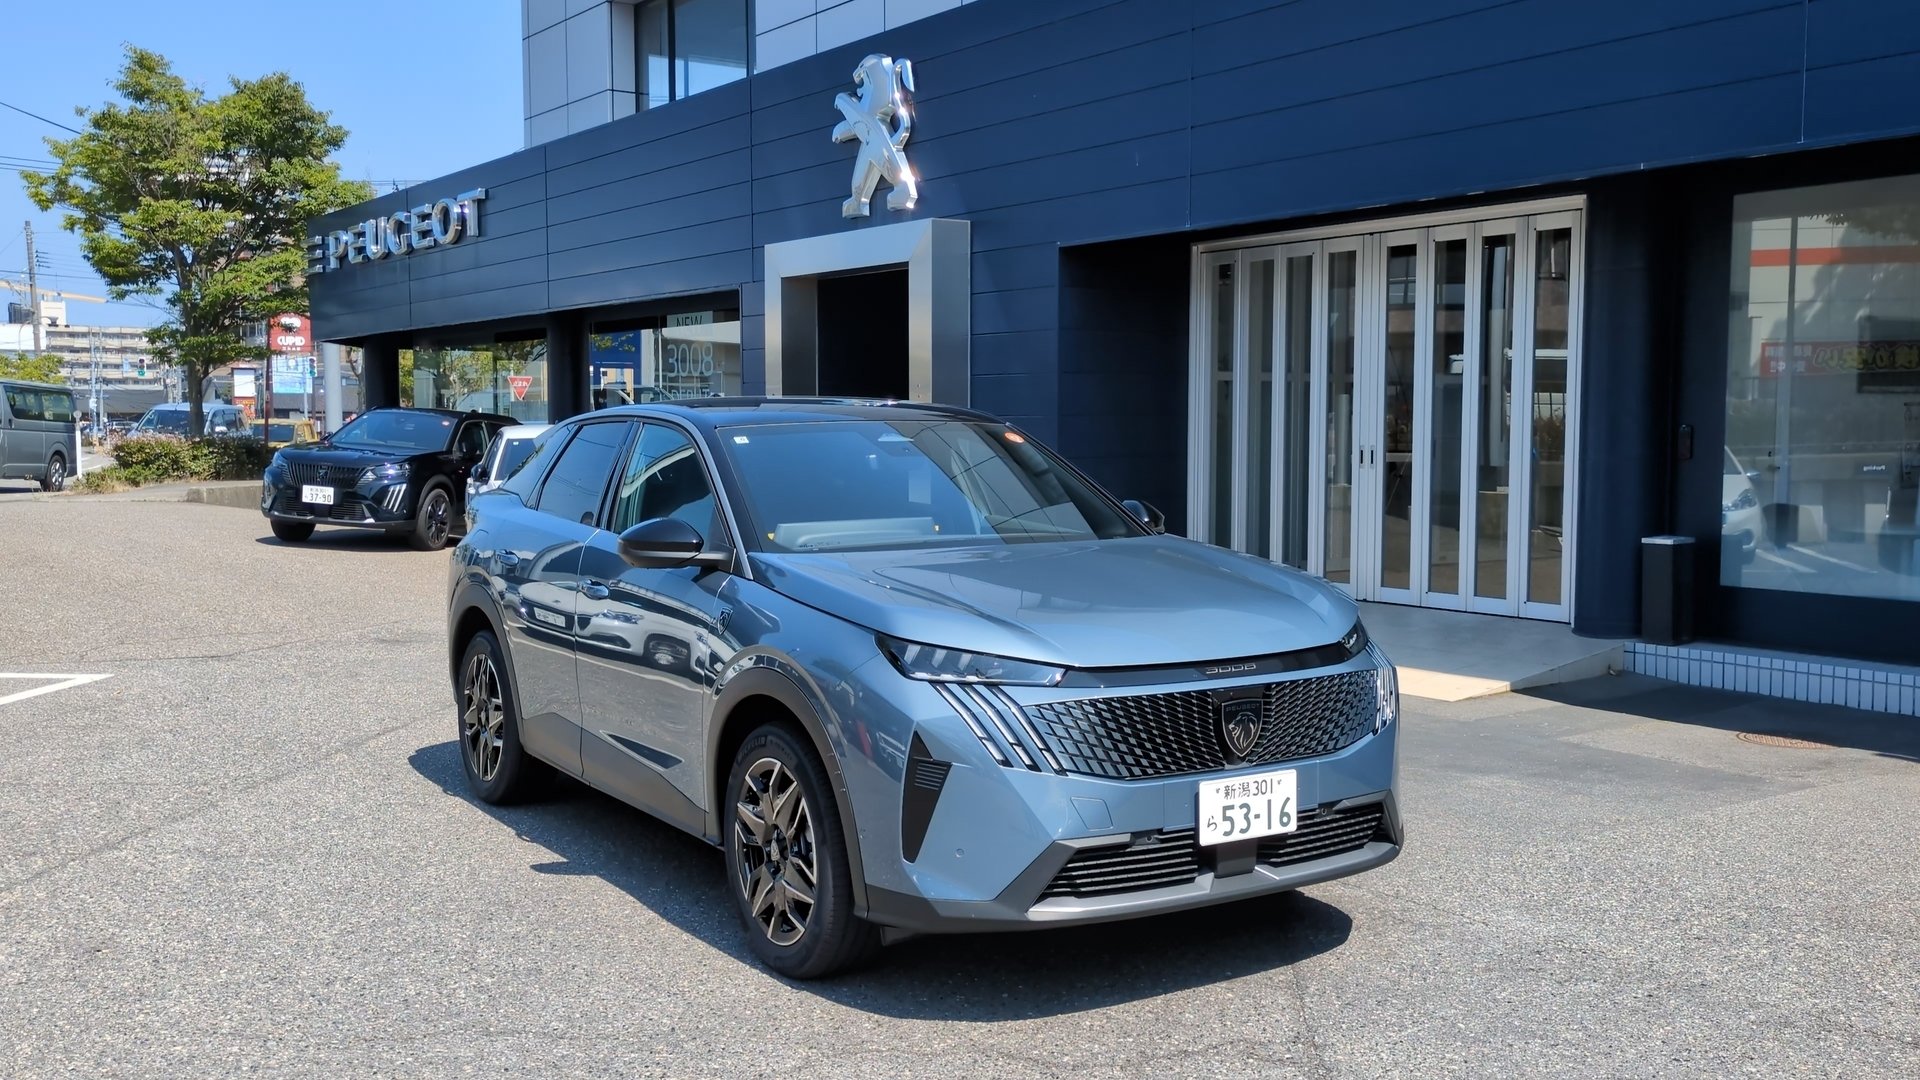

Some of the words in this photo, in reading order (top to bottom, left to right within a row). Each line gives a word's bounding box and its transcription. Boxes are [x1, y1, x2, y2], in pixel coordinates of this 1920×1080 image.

[329, 188, 486, 269] PEUGEOT
[676, 315, 703, 327] NEW
[277, 336, 306, 347] CUPID
[667, 342, 714, 378] 3008
[309, 493, 332, 503] 37-90
[1207, 815, 1218, 831] ら
[1222, 796, 1291, 837] 53-16
